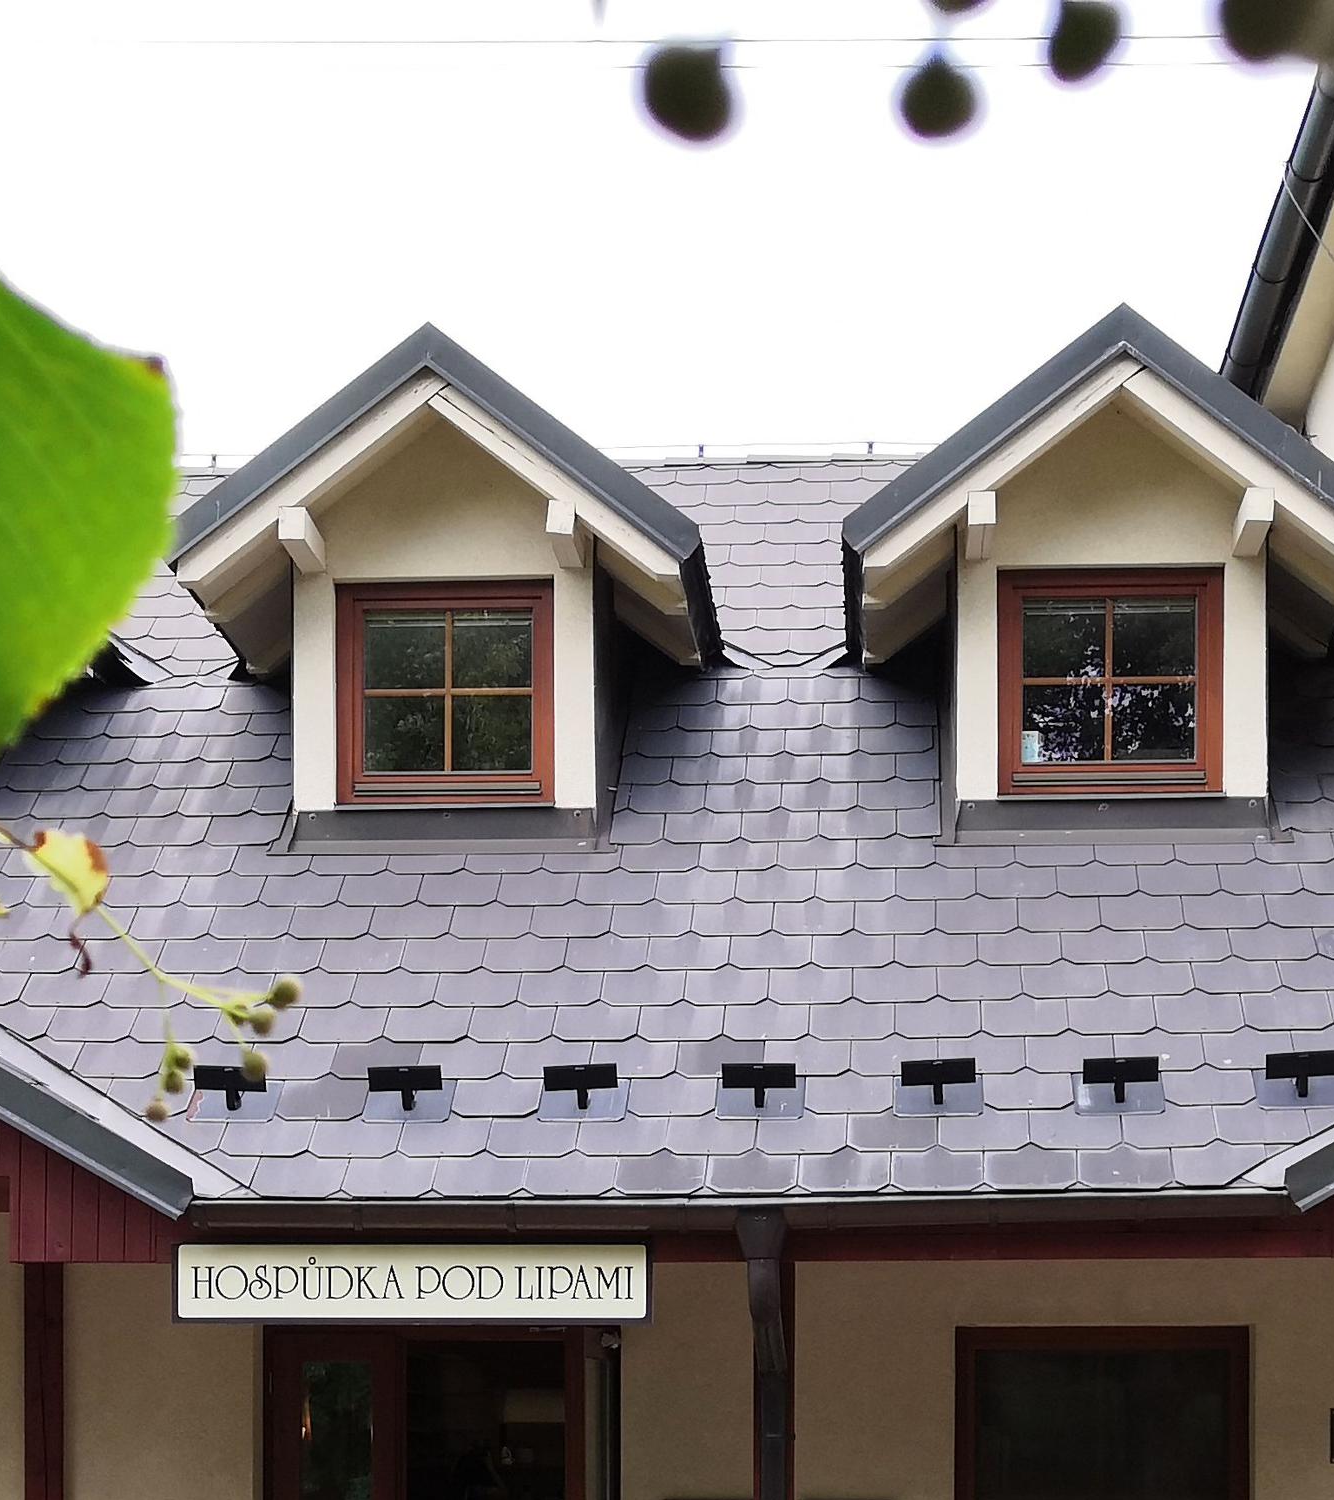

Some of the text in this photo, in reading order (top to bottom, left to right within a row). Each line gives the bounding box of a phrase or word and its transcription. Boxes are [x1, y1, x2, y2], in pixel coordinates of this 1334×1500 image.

[191, 1256, 634, 1300] HOSPŮDKA POD LIPAMI
